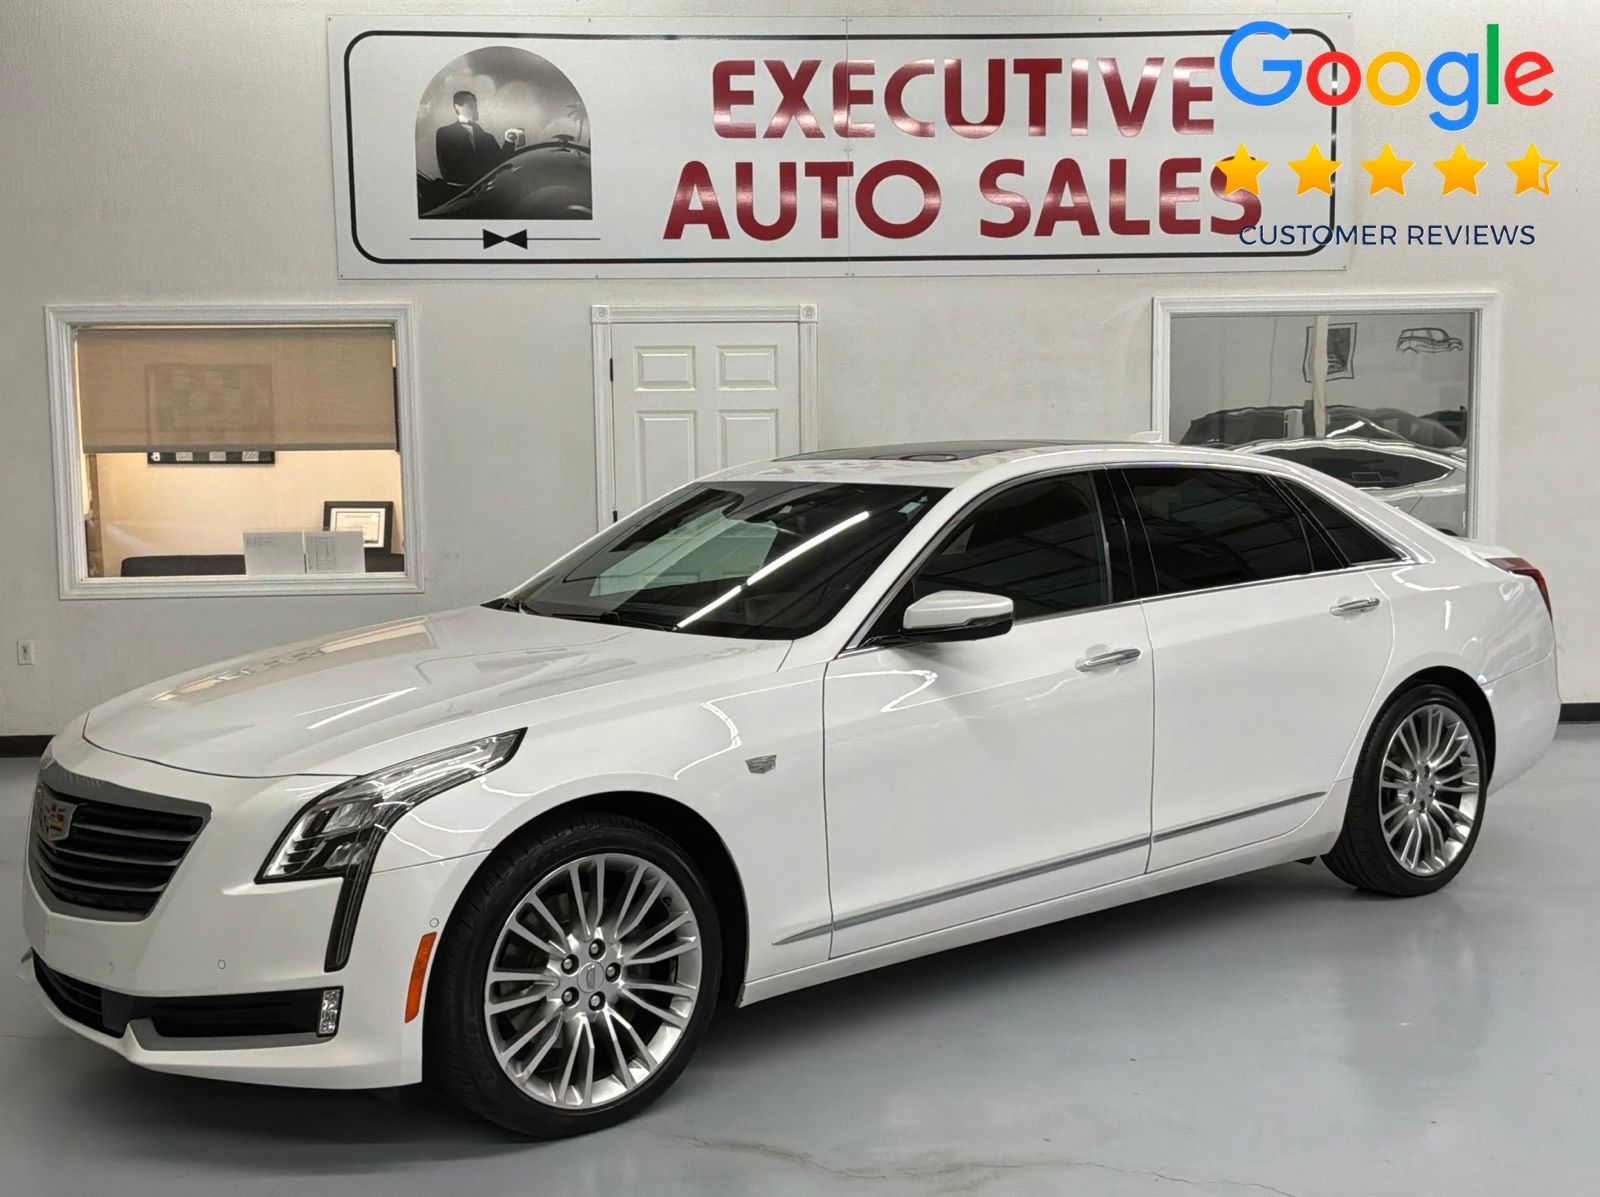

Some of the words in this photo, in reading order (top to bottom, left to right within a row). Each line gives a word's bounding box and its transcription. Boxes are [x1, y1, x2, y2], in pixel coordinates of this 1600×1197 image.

[713, 56, 1215, 139] EXECUTIVE
[663, 159, 941, 241] AUTO
[979, 156, 1262, 238] SALES
